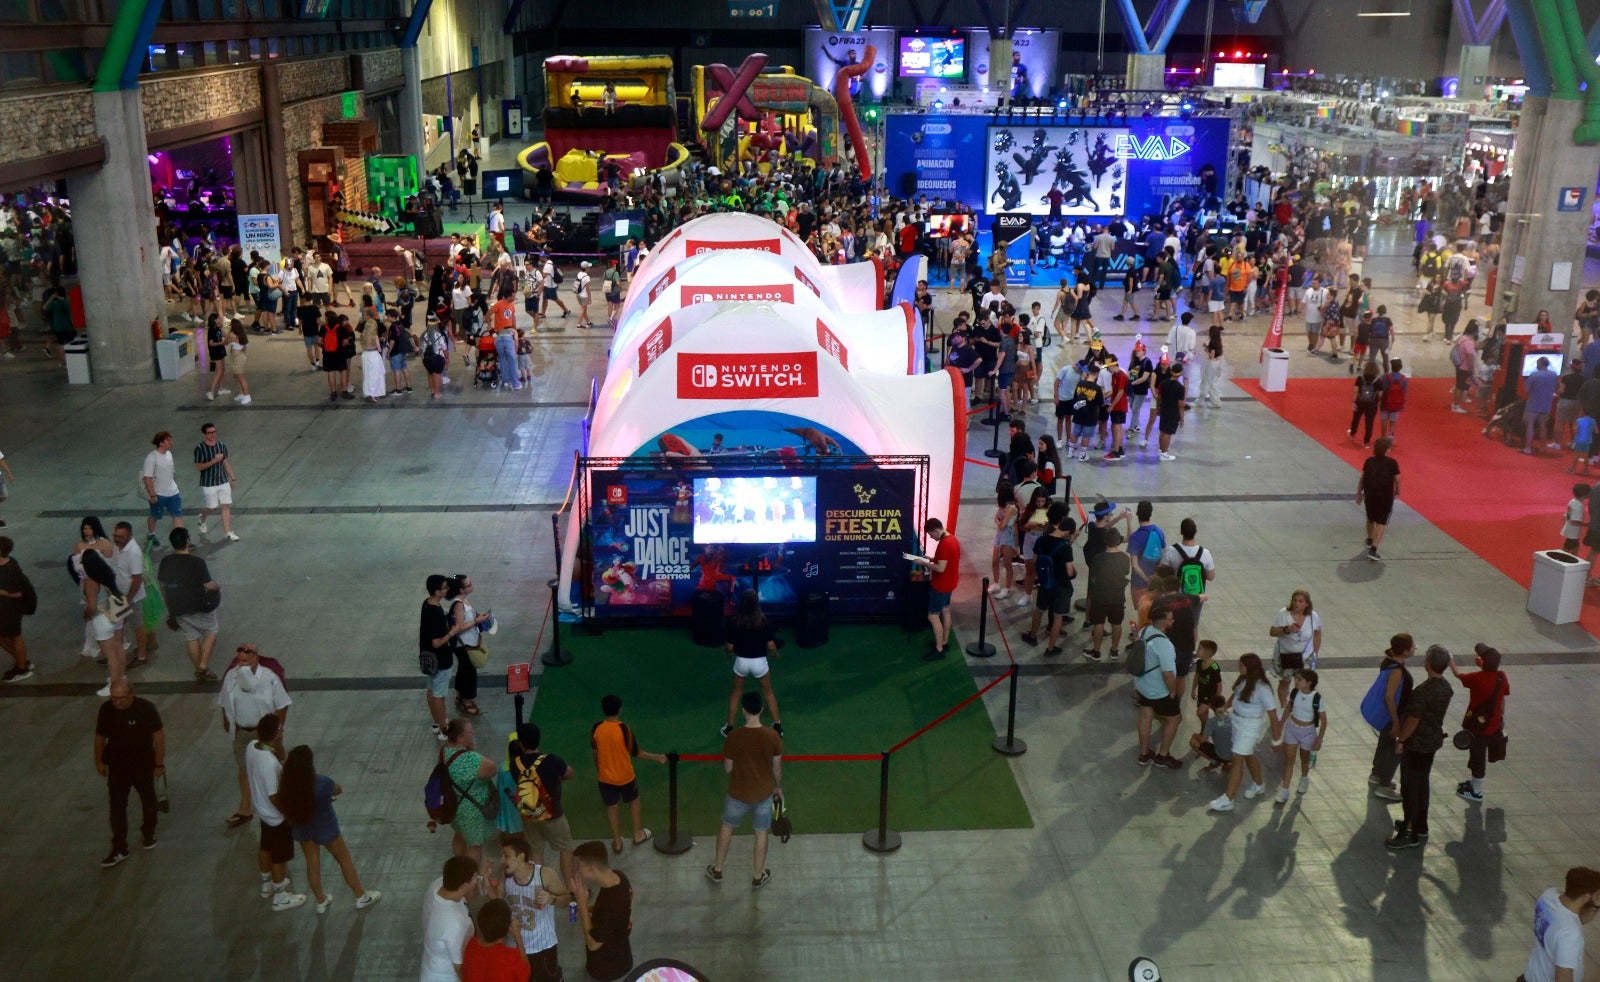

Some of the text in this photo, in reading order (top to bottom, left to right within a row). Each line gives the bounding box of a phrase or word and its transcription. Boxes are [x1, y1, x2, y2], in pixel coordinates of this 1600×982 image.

[839, 37, 866, 45] FIFA 23
[753, 81, 806, 102] RUN
[1114, 134, 1191, 161] EVAD
[916, 158, 955, 169] ANIMACIÓN
[917, 180, 957, 189] IDEOJUEGOS
[1000, 216, 1027, 226] EVAD
[716, 292, 782, 300] NINTENDO
[721, 363, 802, 373] NINTENDO
[721, 372, 803, 388] SWITCH
[826, 509, 902, 518] DESCUBRE UNA
[624, 508, 671, 540] JUST
[825, 518, 902, 534] FIESTA
[634, 536, 690, 581] DANCE
[655, 564, 691, 574] 2023
